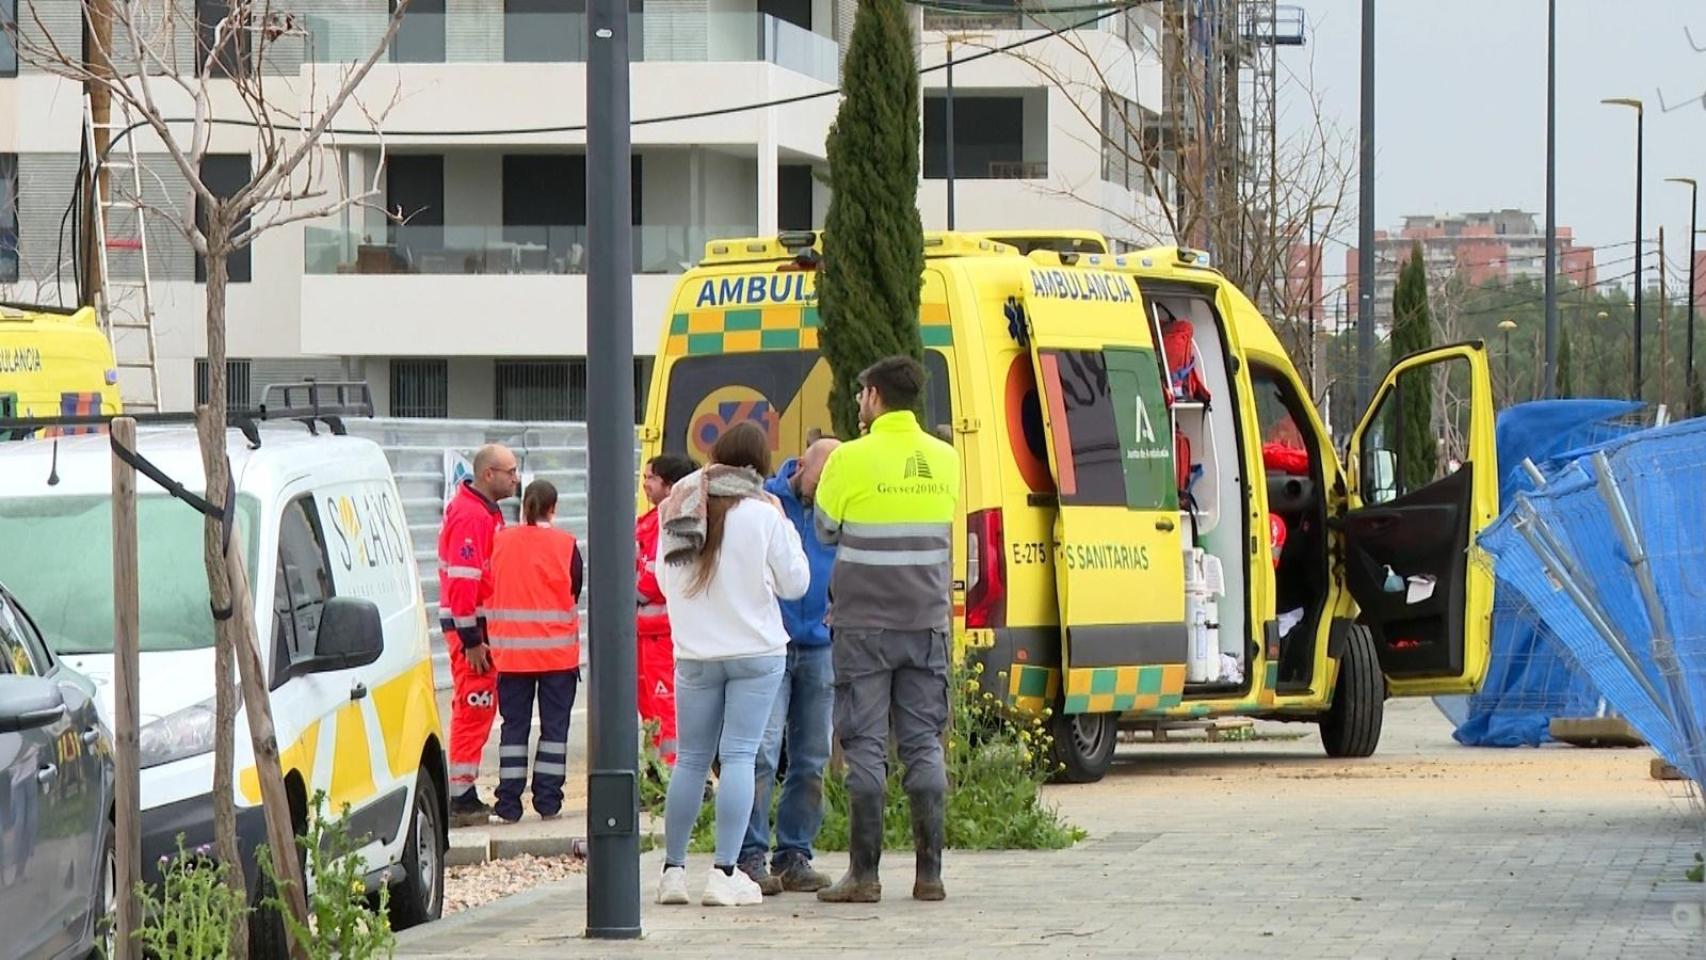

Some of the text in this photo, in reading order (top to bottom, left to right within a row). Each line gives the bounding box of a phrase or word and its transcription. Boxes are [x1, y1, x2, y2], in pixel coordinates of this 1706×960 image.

[1031, 270, 1134, 303] AMBULANCIA
[1013, 543, 1046, 564] E-275
[1077, 546, 1149, 570] SANITARIAS
